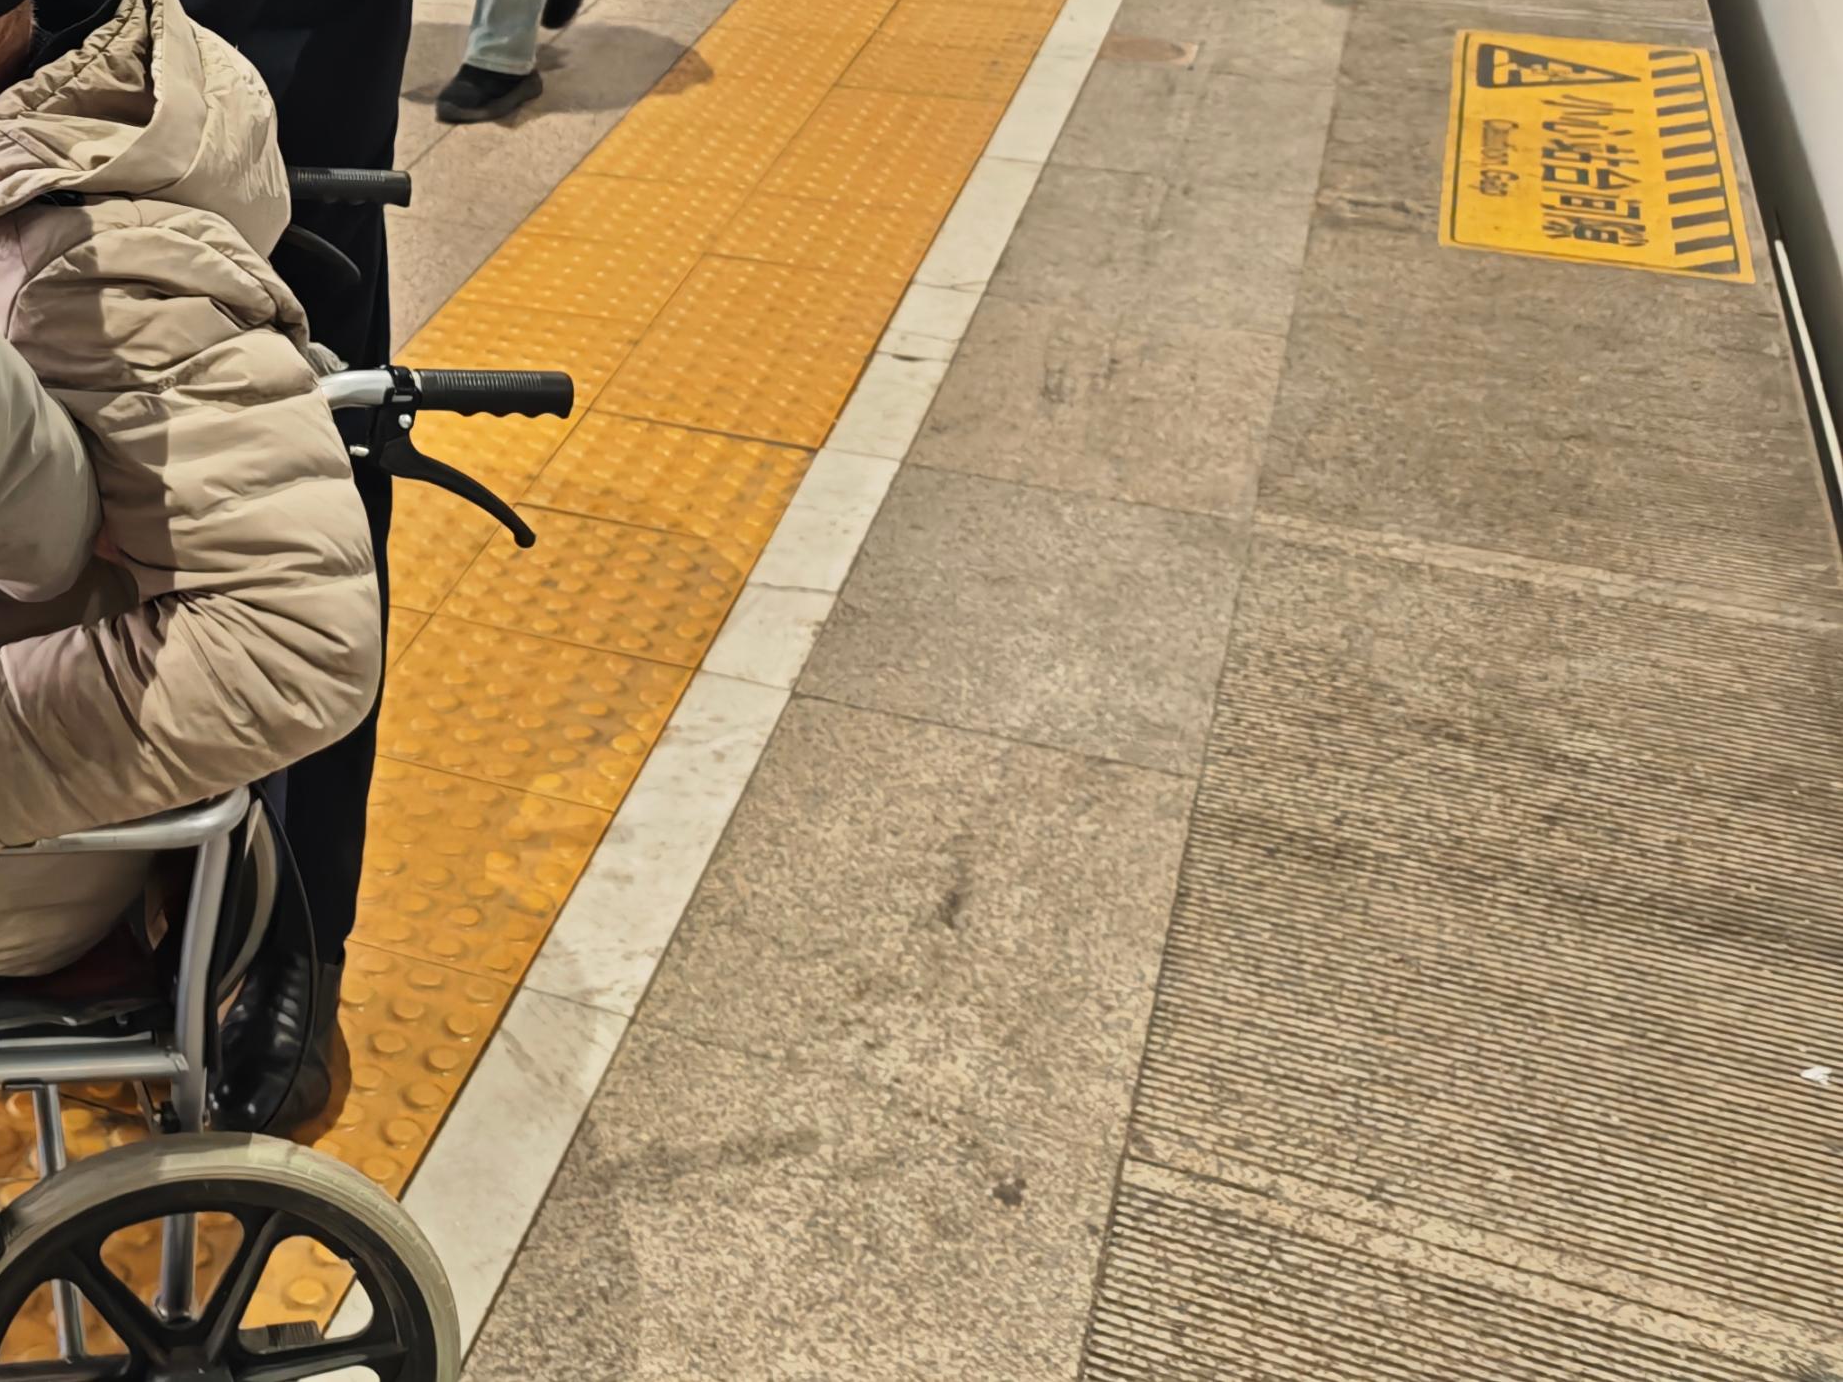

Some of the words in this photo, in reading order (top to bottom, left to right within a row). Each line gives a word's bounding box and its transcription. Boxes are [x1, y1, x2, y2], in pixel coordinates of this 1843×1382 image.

[1542, 95, 1649, 246] 小心站台间隙
